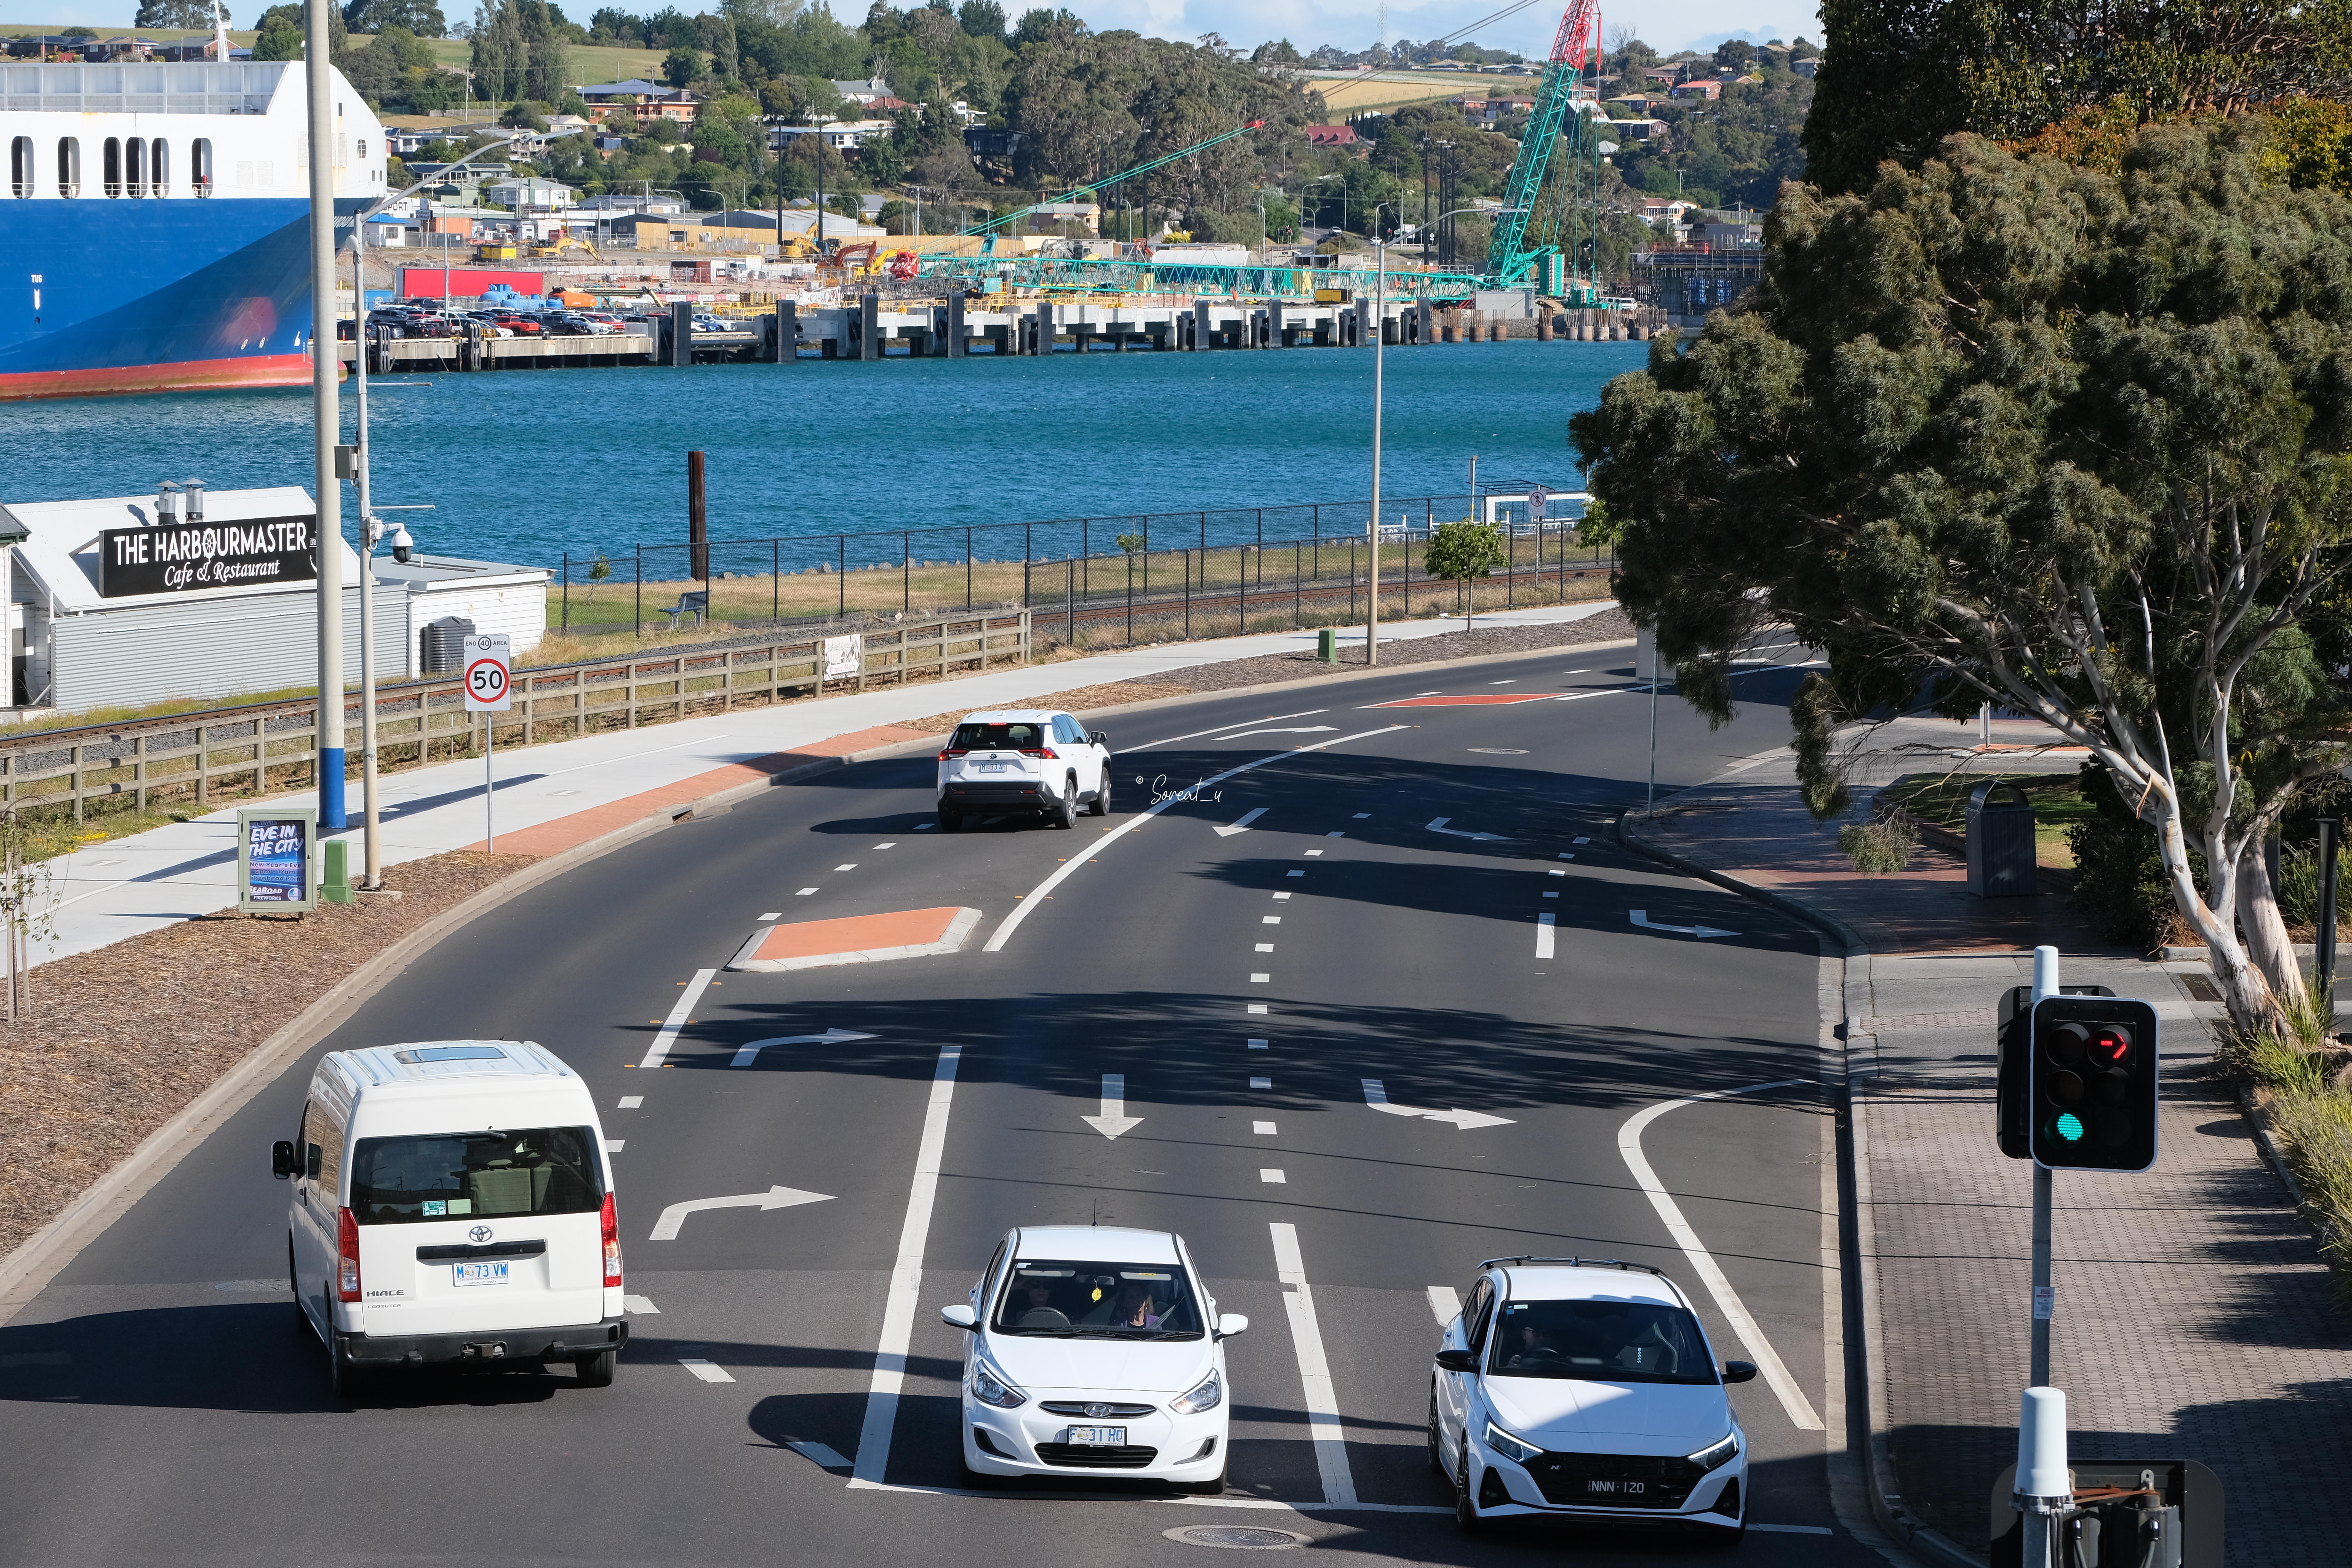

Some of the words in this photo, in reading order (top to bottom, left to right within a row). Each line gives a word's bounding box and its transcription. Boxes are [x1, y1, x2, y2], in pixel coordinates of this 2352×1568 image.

[31, 274, 42, 283] TUG
[114, 534, 149, 565] THE
[165, 562, 192, 590] Cafe
[197, 563, 210, 582] &
[214, 559, 280, 583] Restaurant
[474, 670, 502, 690] 50
[251, 826, 279, 842] EVE
[280, 825, 296, 838] IN
[249, 841, 274, 856] THE
[275, 838, 304, 853] CITY
[457, 1266, 464, 1278] M
[475, 1265, 489, 1277] 73
[493, 1263, 507, 1276] VW
[1069, 1428, 1077, 1441] F
[1089, 1429, 1102, 1442] 31
[1624, 1482, 1644, 1493] 120
